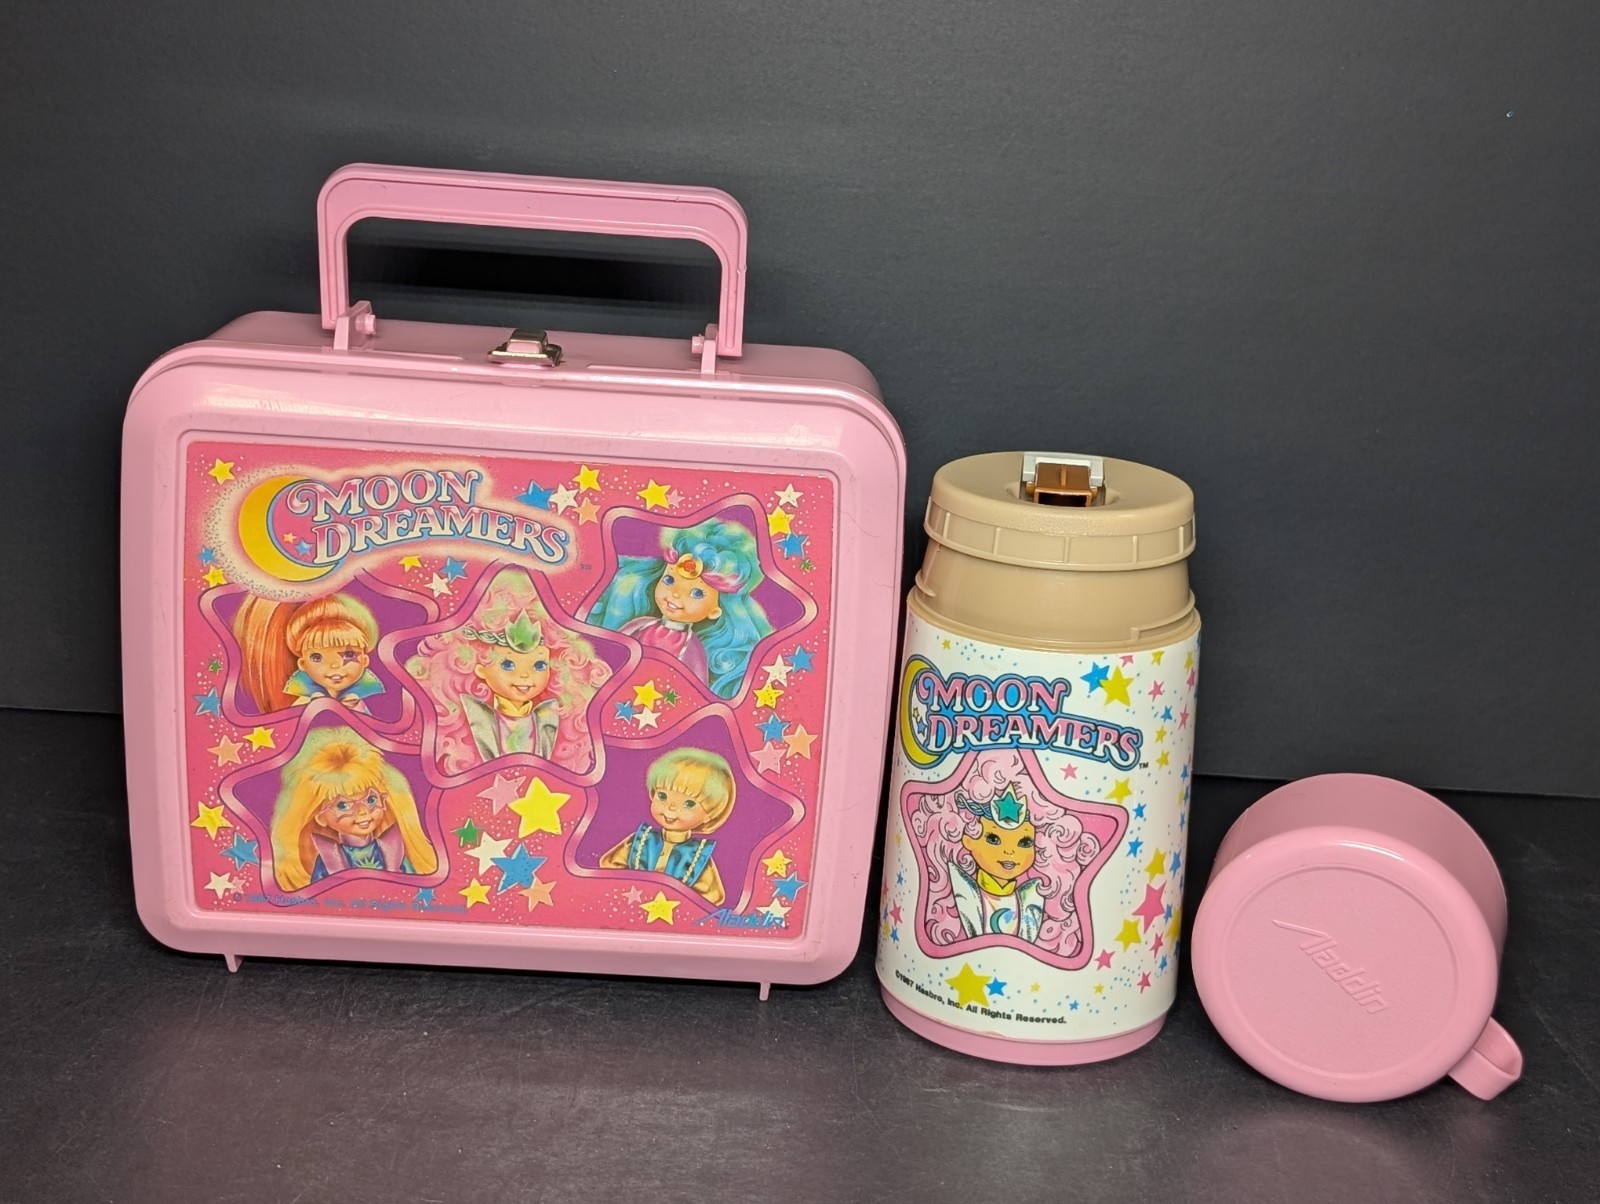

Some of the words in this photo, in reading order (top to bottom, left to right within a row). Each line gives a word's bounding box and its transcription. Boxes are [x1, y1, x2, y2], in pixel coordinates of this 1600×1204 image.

[286, 469, 481, 522] MOON
[311, 505, 568, 565] DREAMERS
[917, 671, 1067, 714] MOON
[926, 714, 1141, 767] DREAMERS
[694, 908, 785, 928] Aladdin
[1271, 919, 1388, 1014] Aladdin
[915, 983, 945, 1006] Hasbro,
[947, 998, 963, 1010] Inc.
[966, 1004, 978, 1014] All
[980, 1007, 1012, 1020] Rights
[1015, 1013, 1067, 1024] Reserved.
